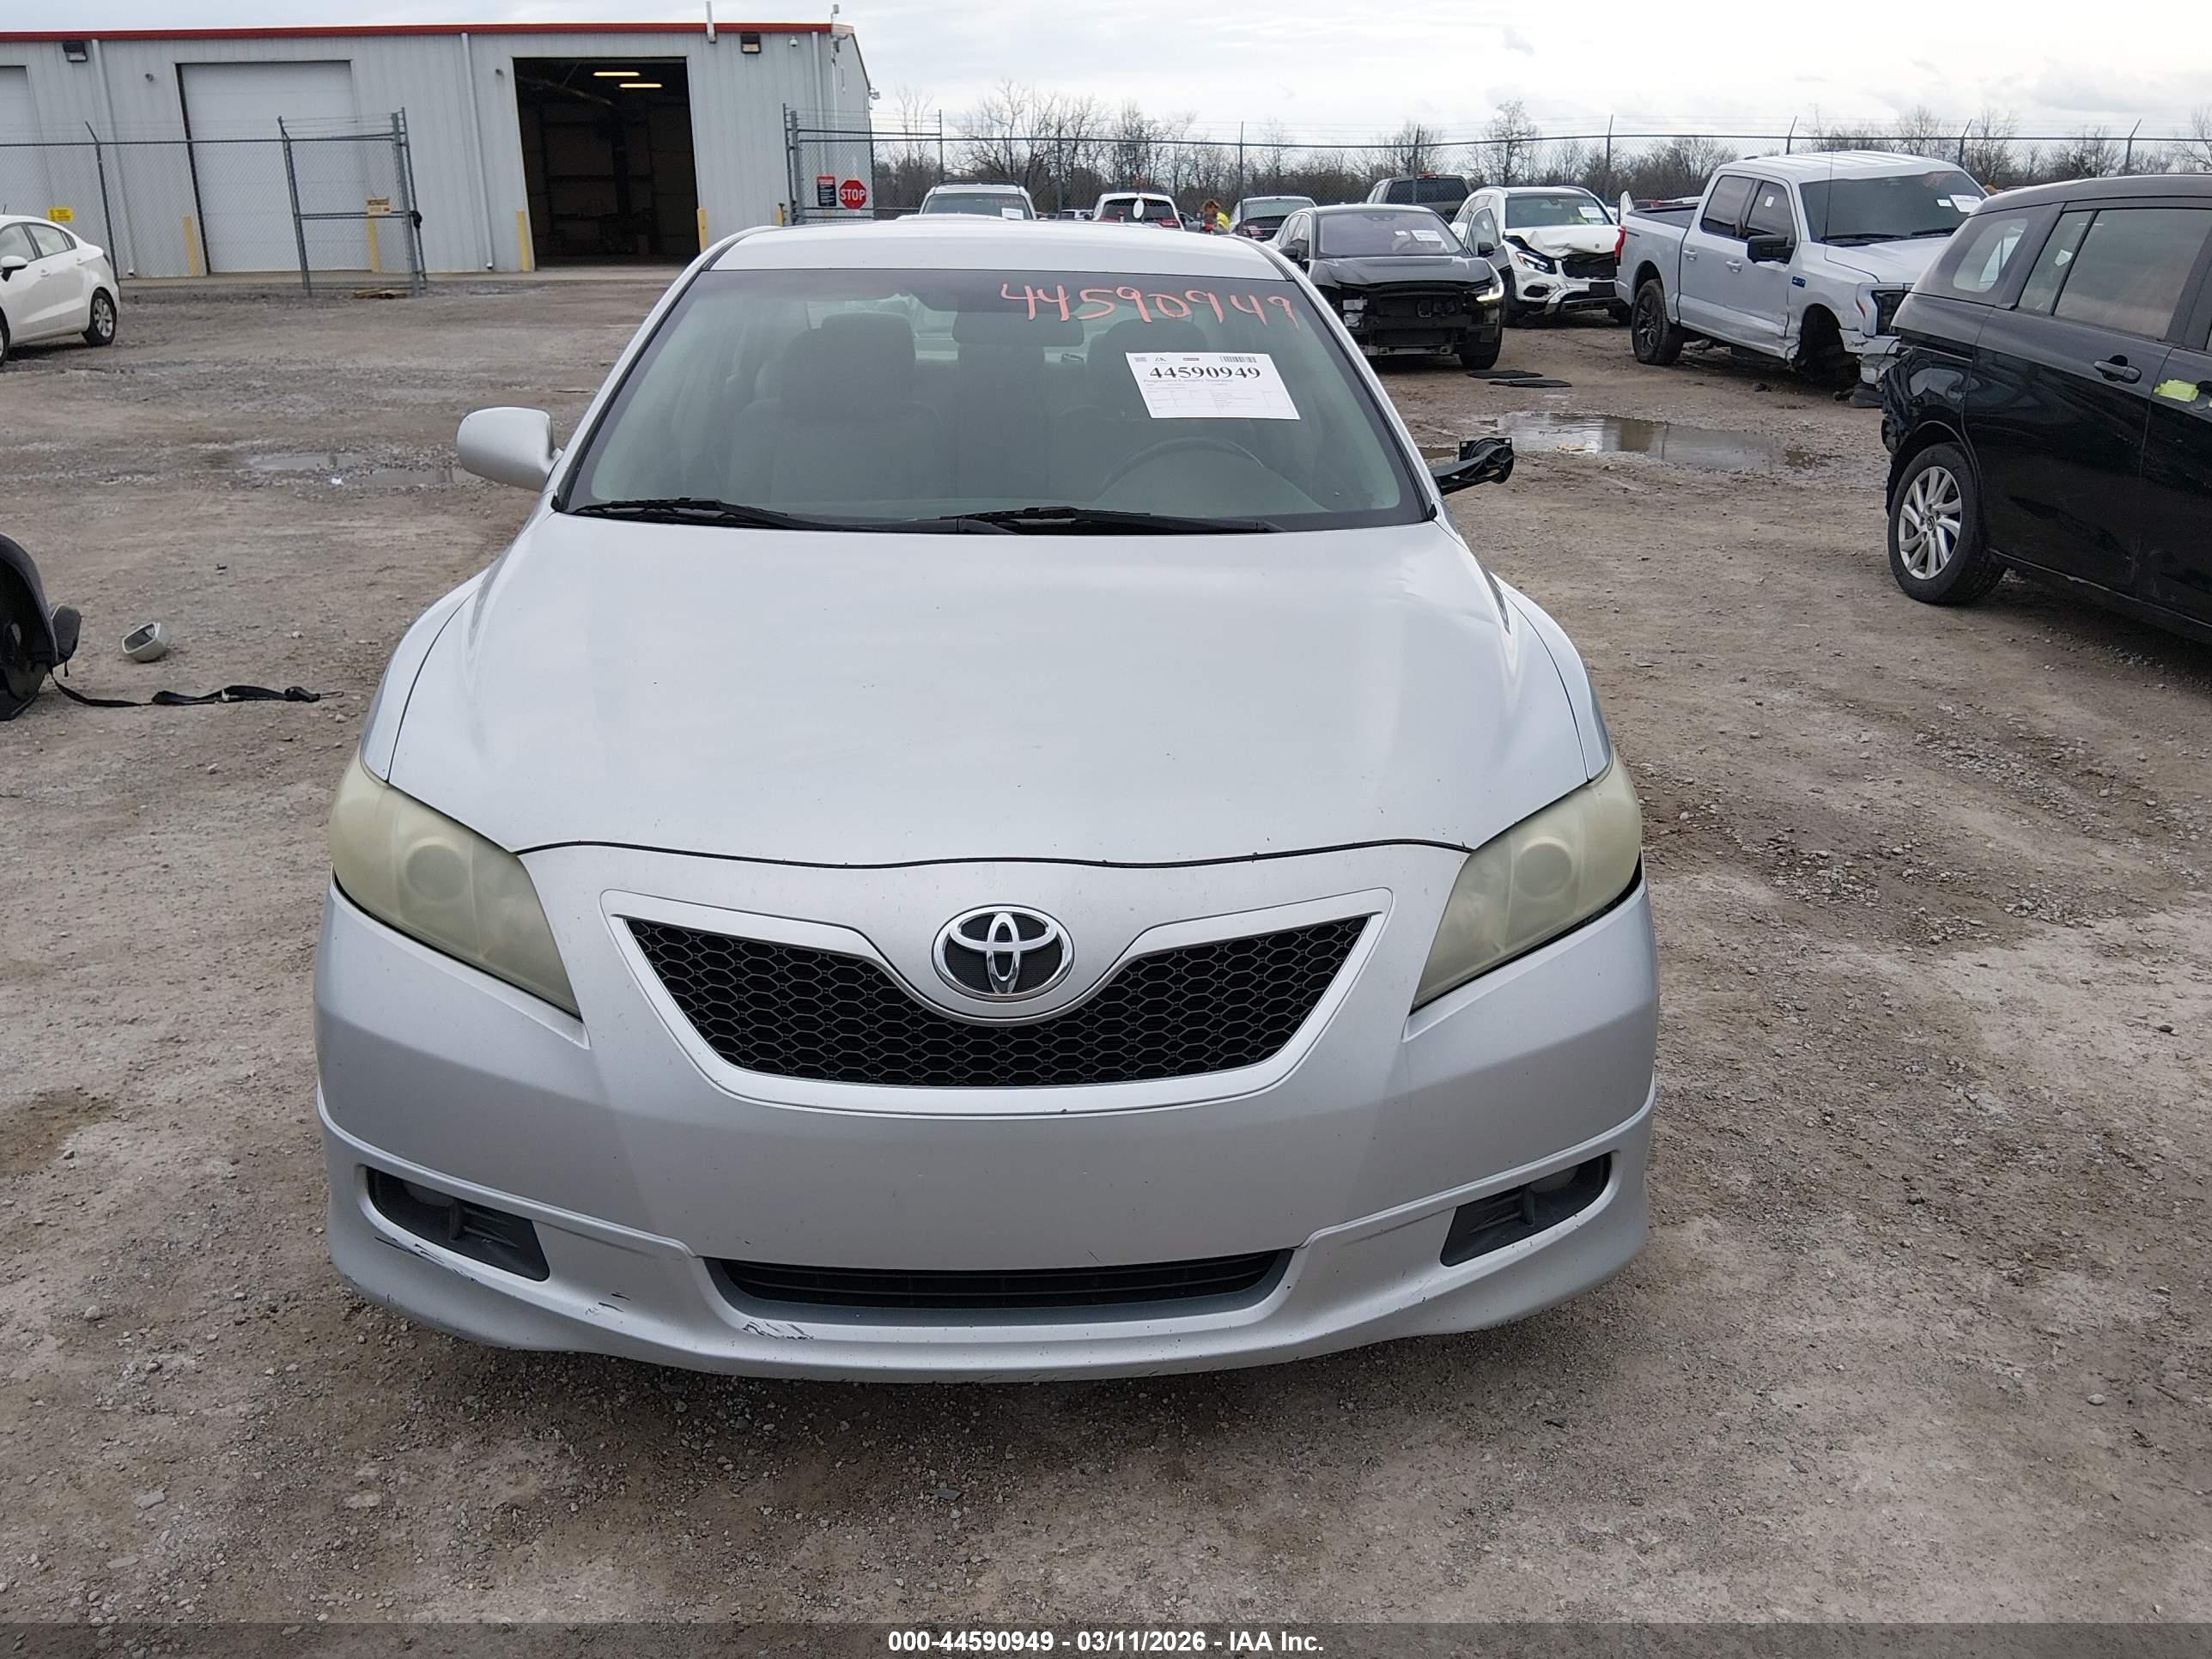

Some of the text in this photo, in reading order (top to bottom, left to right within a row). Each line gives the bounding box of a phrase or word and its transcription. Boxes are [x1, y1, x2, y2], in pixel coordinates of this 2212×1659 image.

[840, 189, 866, 201] STOP
[1000, 283, 1299, 330] 44590949
[1149, 366, 1261, 380] 44590949
